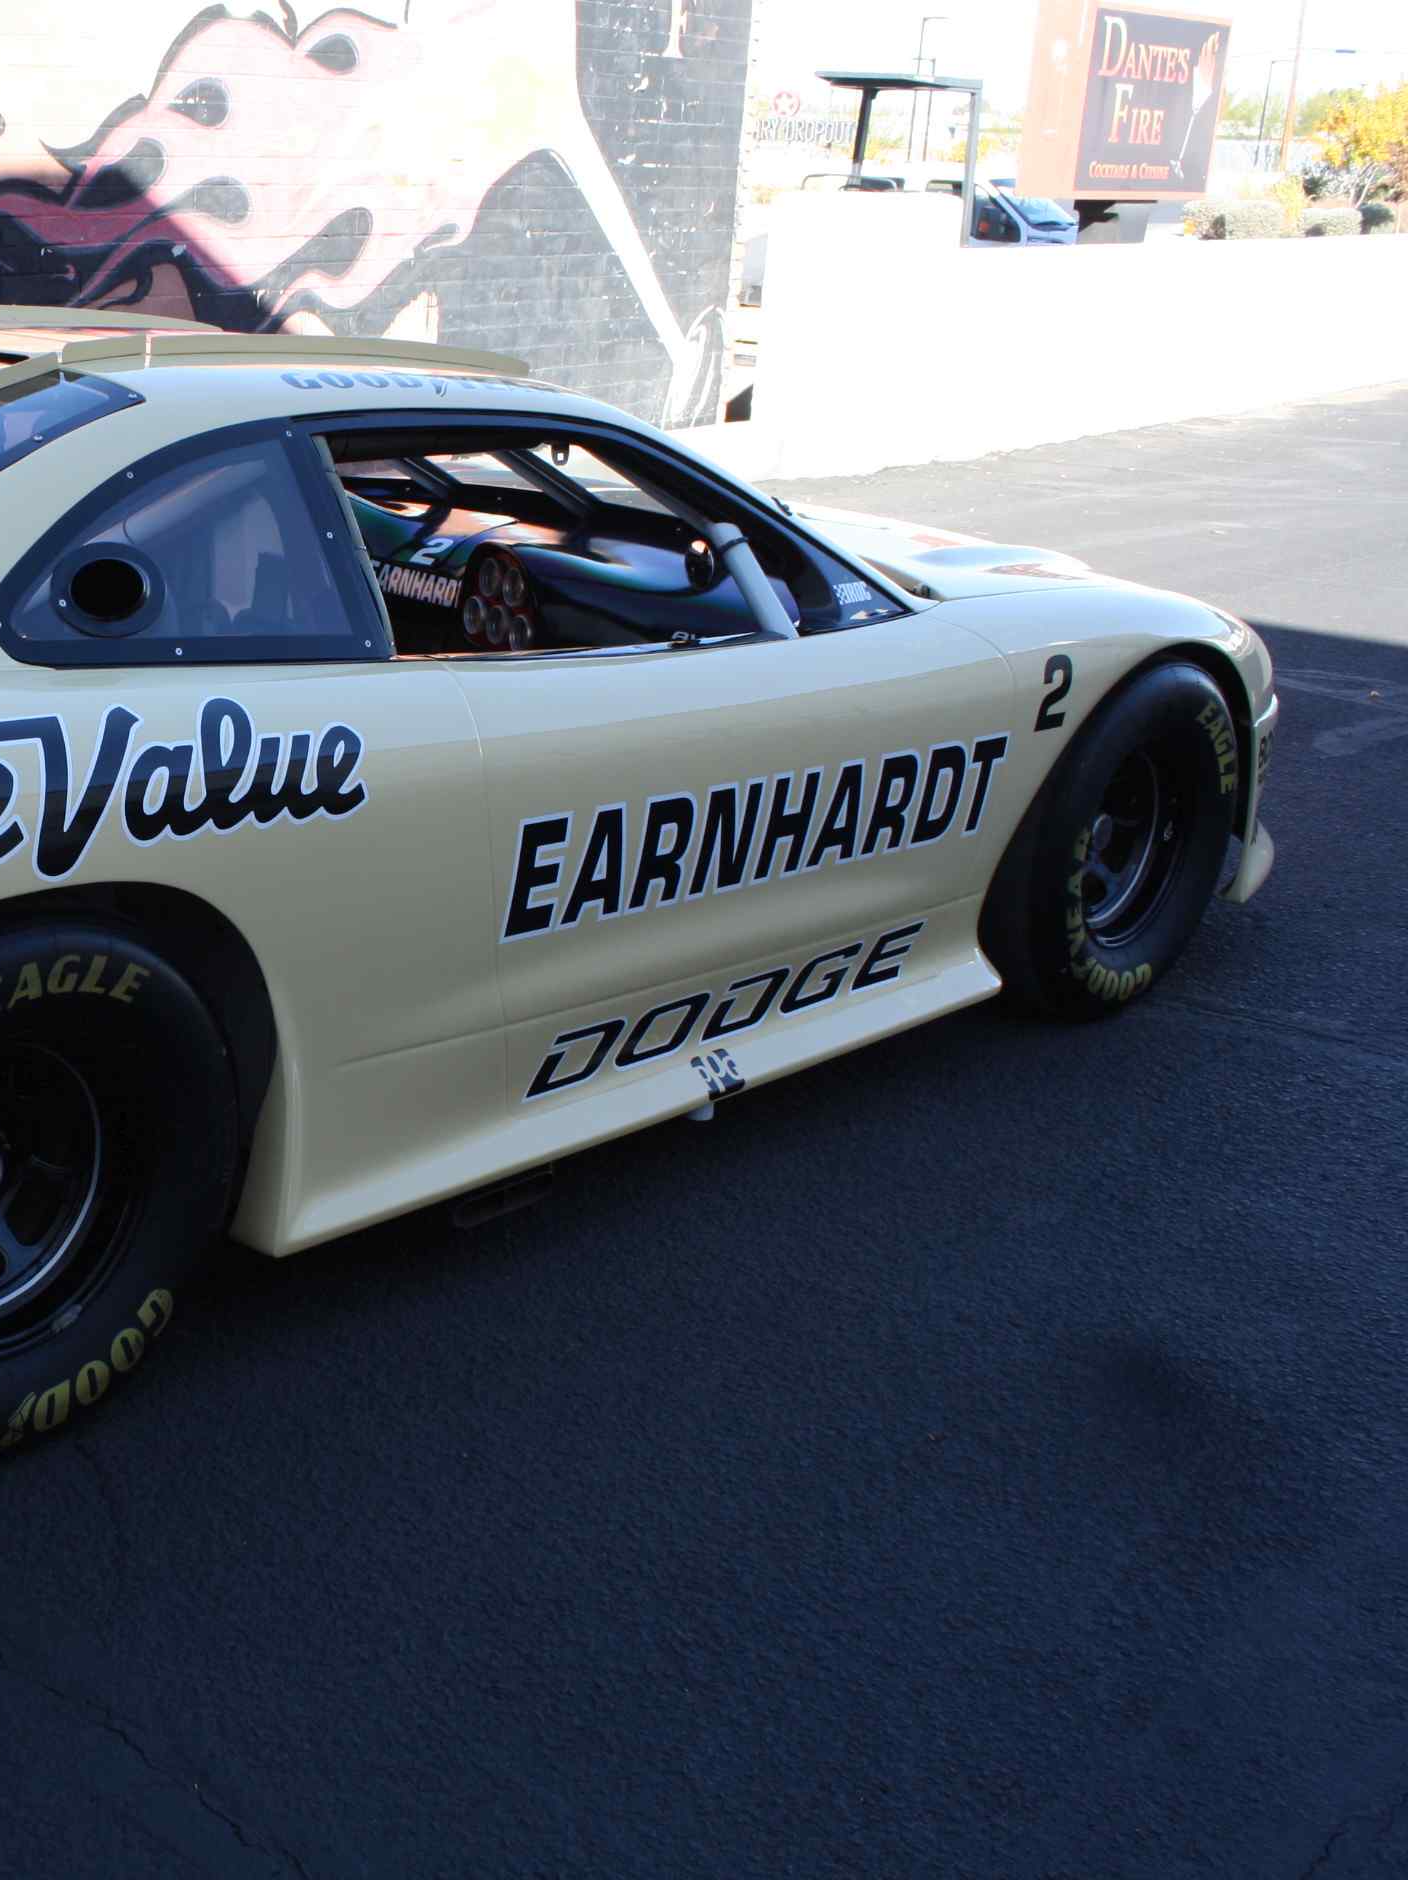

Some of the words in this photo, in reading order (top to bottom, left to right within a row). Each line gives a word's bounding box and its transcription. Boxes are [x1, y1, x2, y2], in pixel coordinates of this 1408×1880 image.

[1108, 83, 1164, 144] FIRE
[410, 537, 454, 566] 2
[1033, 654, 1072, 732] 2
[1195, 701, 1239, 796] EAGLE
[498, 732, 1012, 944] EARNHARDT
[522, 919, 928, 1104] DODGE
